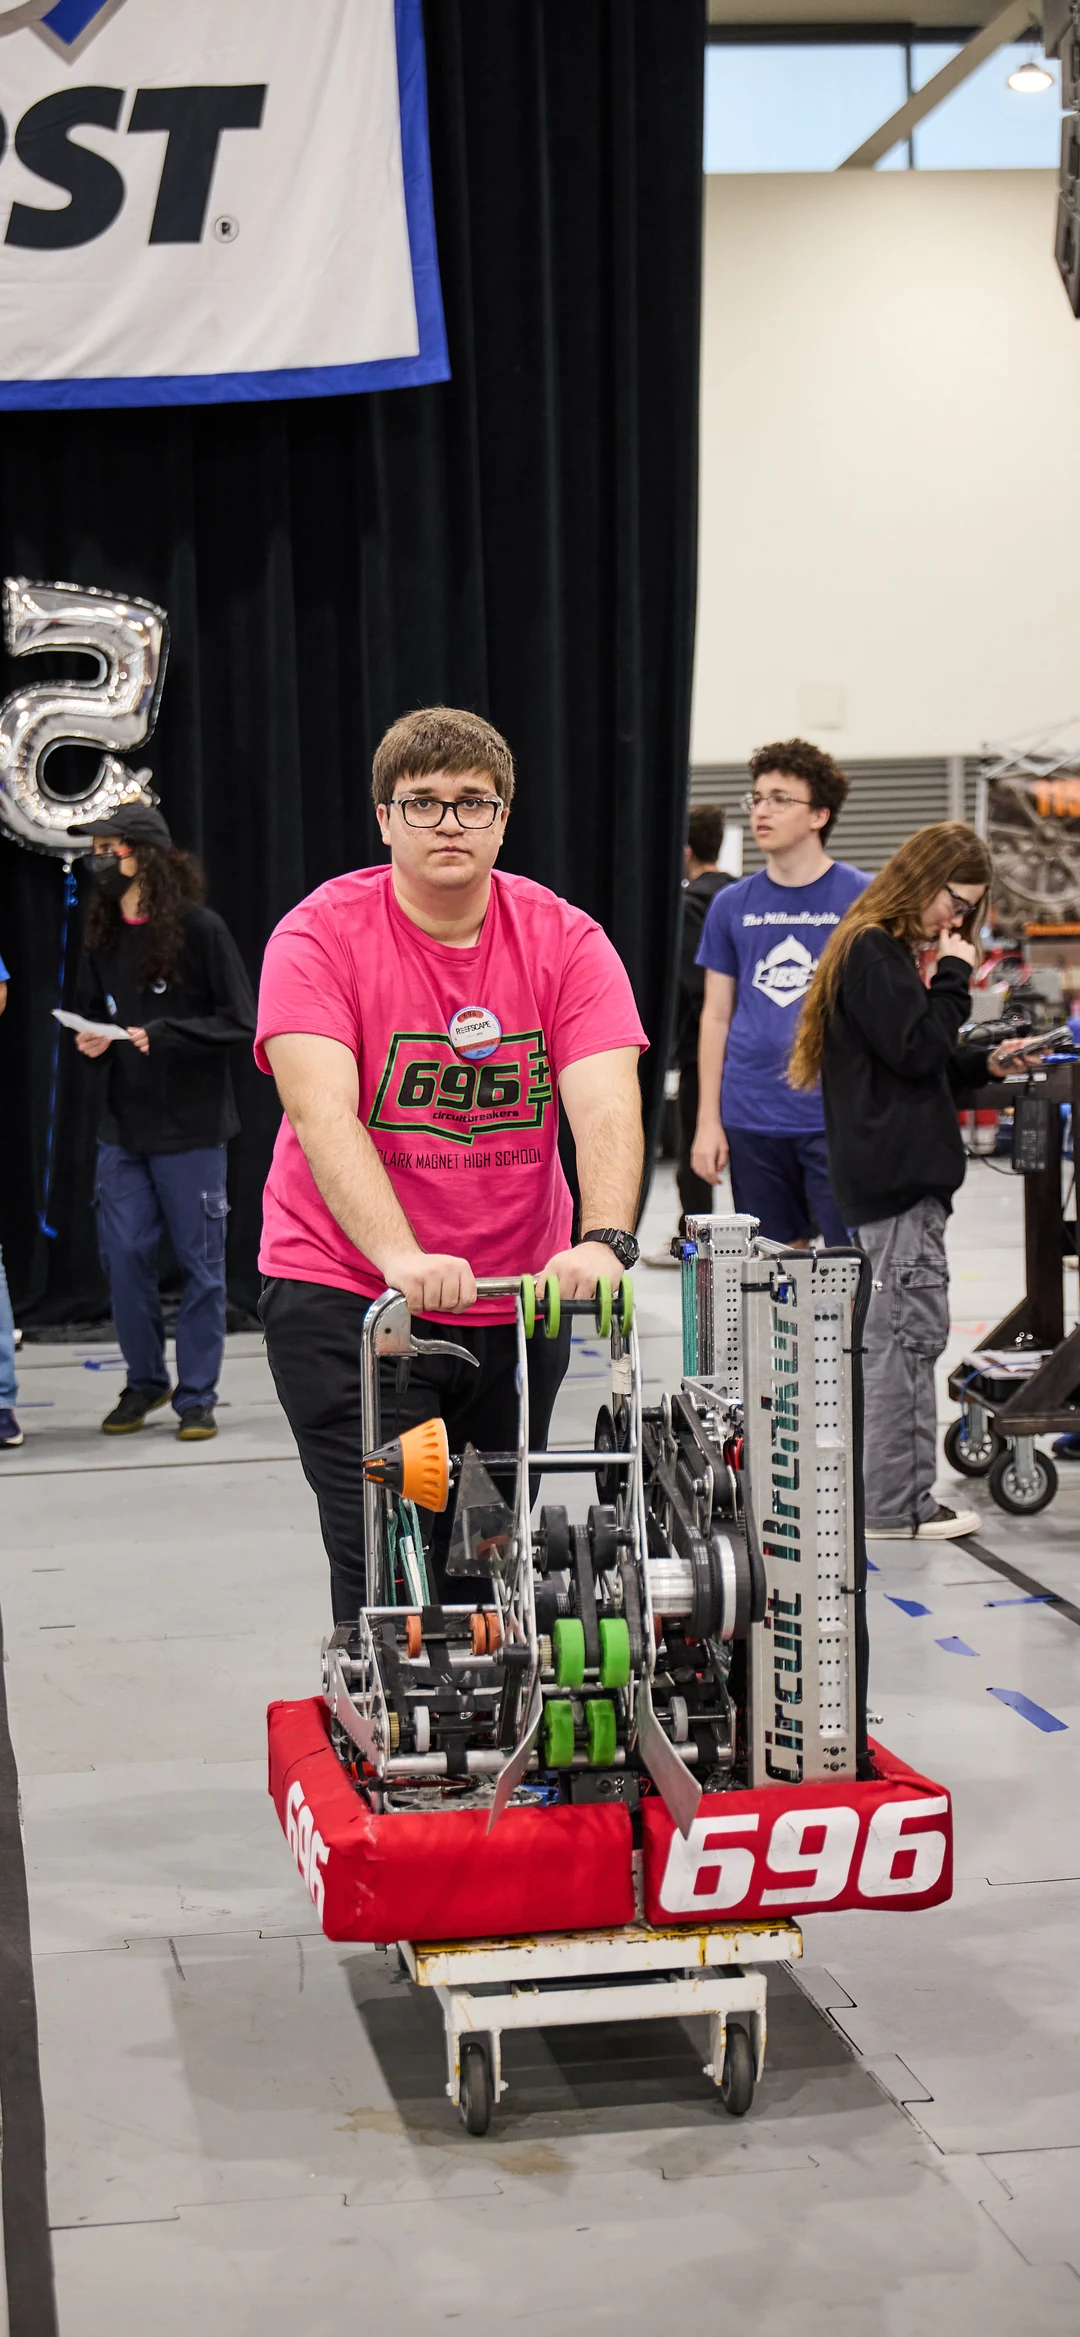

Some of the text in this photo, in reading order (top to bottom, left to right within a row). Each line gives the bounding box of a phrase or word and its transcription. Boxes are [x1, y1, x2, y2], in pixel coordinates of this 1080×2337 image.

[0, 84, 268, 251] ST
[743, 913, 763, 927] The
[767, 966, 811, 988] 1836
[455, 1020, 492, 1036] REEFSCAPE
[396, 1061, 521, 1111] 696
[432, 1109, 520, 1123] circuitbreakers
[416, 1153, 460, 1170] MAGNET
[464, 1152, 491, 1168] HIGH
[495, 1148, 544, 1166] SCHOOL
[763, 1588, 803, 1785] Circuit
[287, 1780, 331, 1924] 696
[659, 1796, 949, 1913] 696
